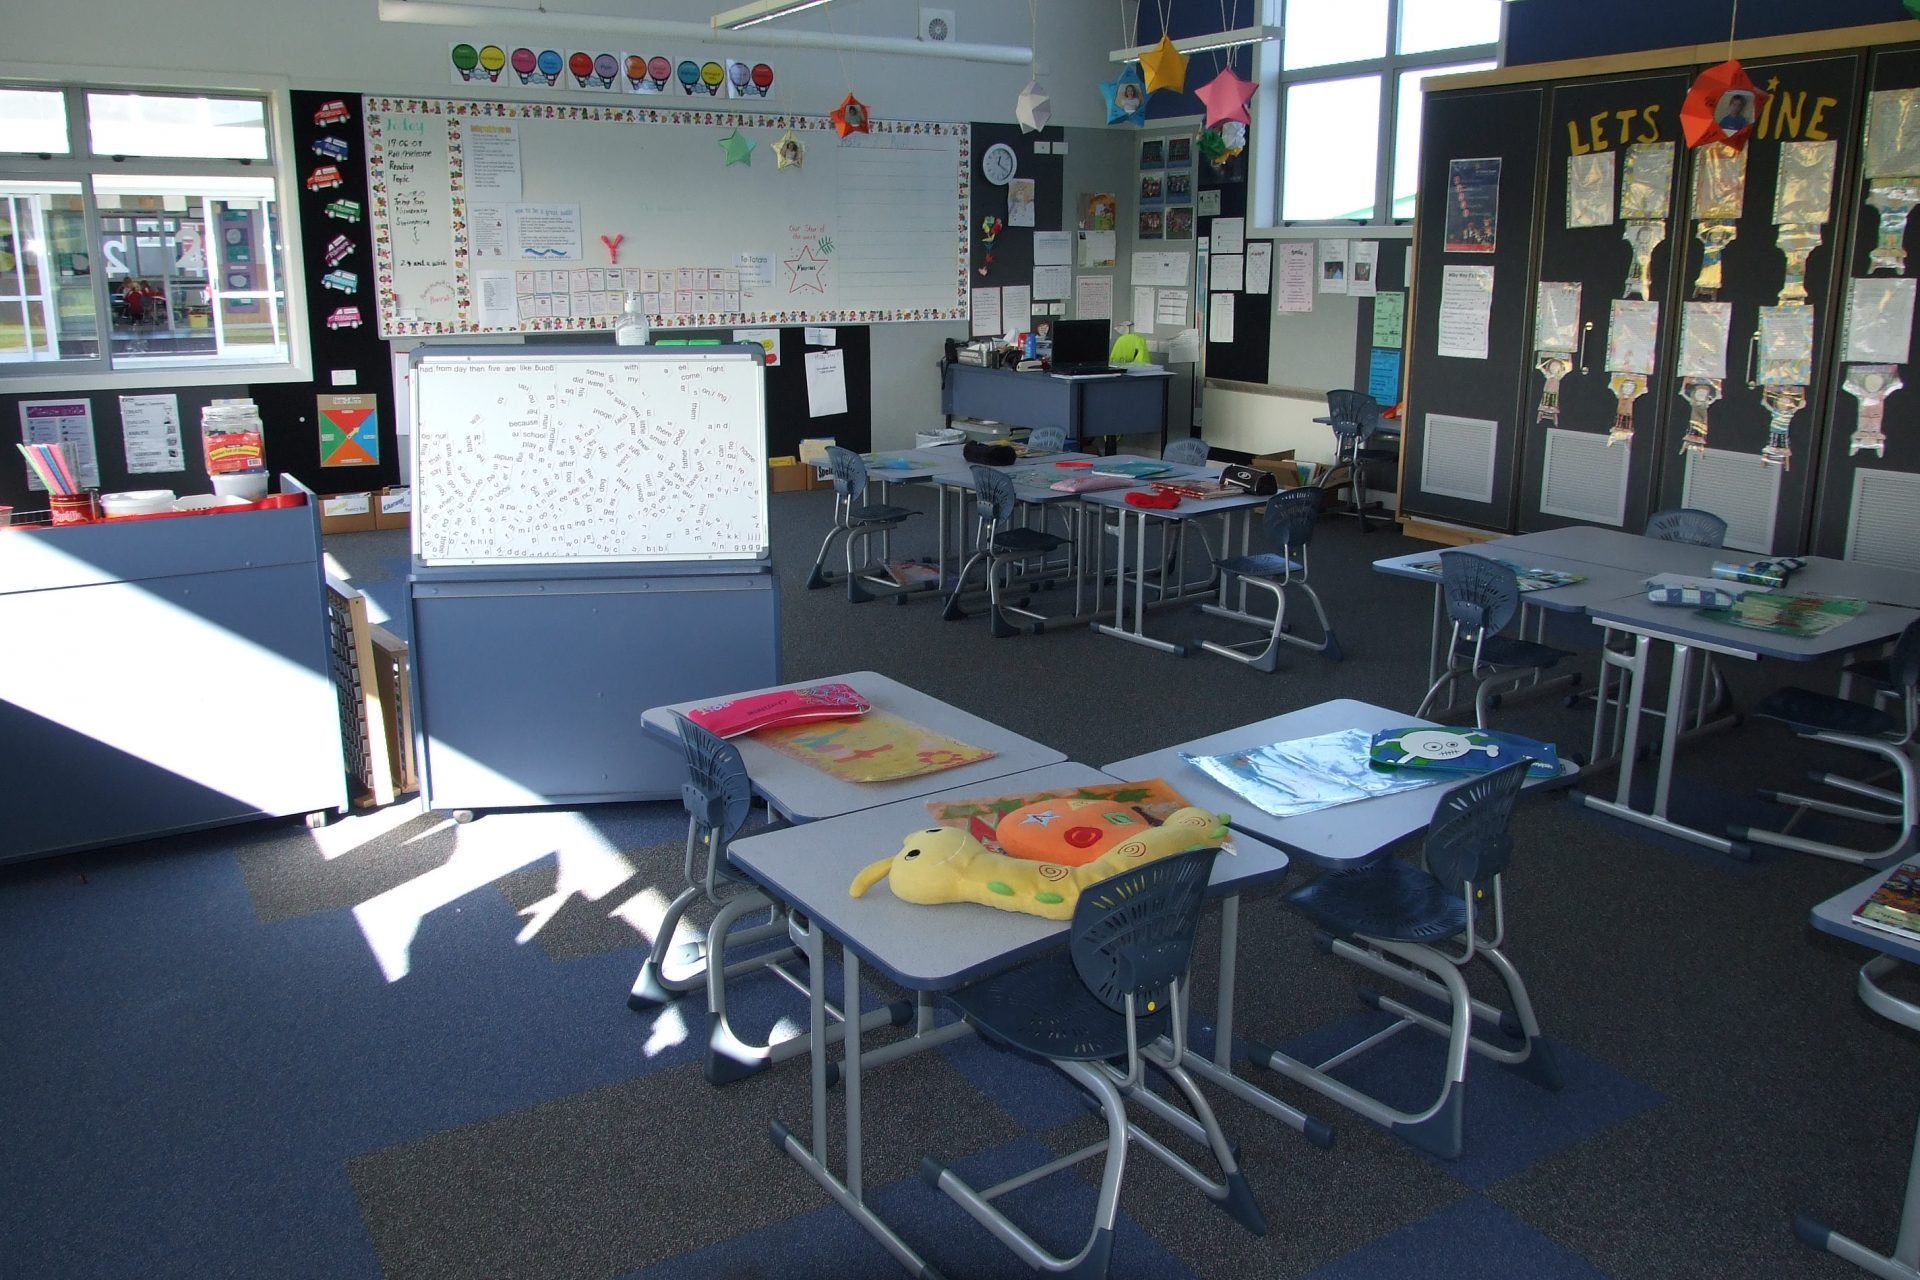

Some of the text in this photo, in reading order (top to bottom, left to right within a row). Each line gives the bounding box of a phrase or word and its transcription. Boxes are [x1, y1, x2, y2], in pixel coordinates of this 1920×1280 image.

[1568, 104, 1660, 156] LETS
[420, 364, 433, 373] had
[436, 364, 452, 372] from
[454, 365, 467, 373] day
[706, 365, 725, 374] night
[586, 369, 605, 378] some
[681, 372, 700, 381] come
[572, 376, 584, 384] did
[587, 379, 604, 388] were
[627, 375, 639, 384] my
[509, 419, 539, 428] because
[522, 432, 546, 440] school
[522, 441, 537, 450] play
[739, 446, 756, 464] home
